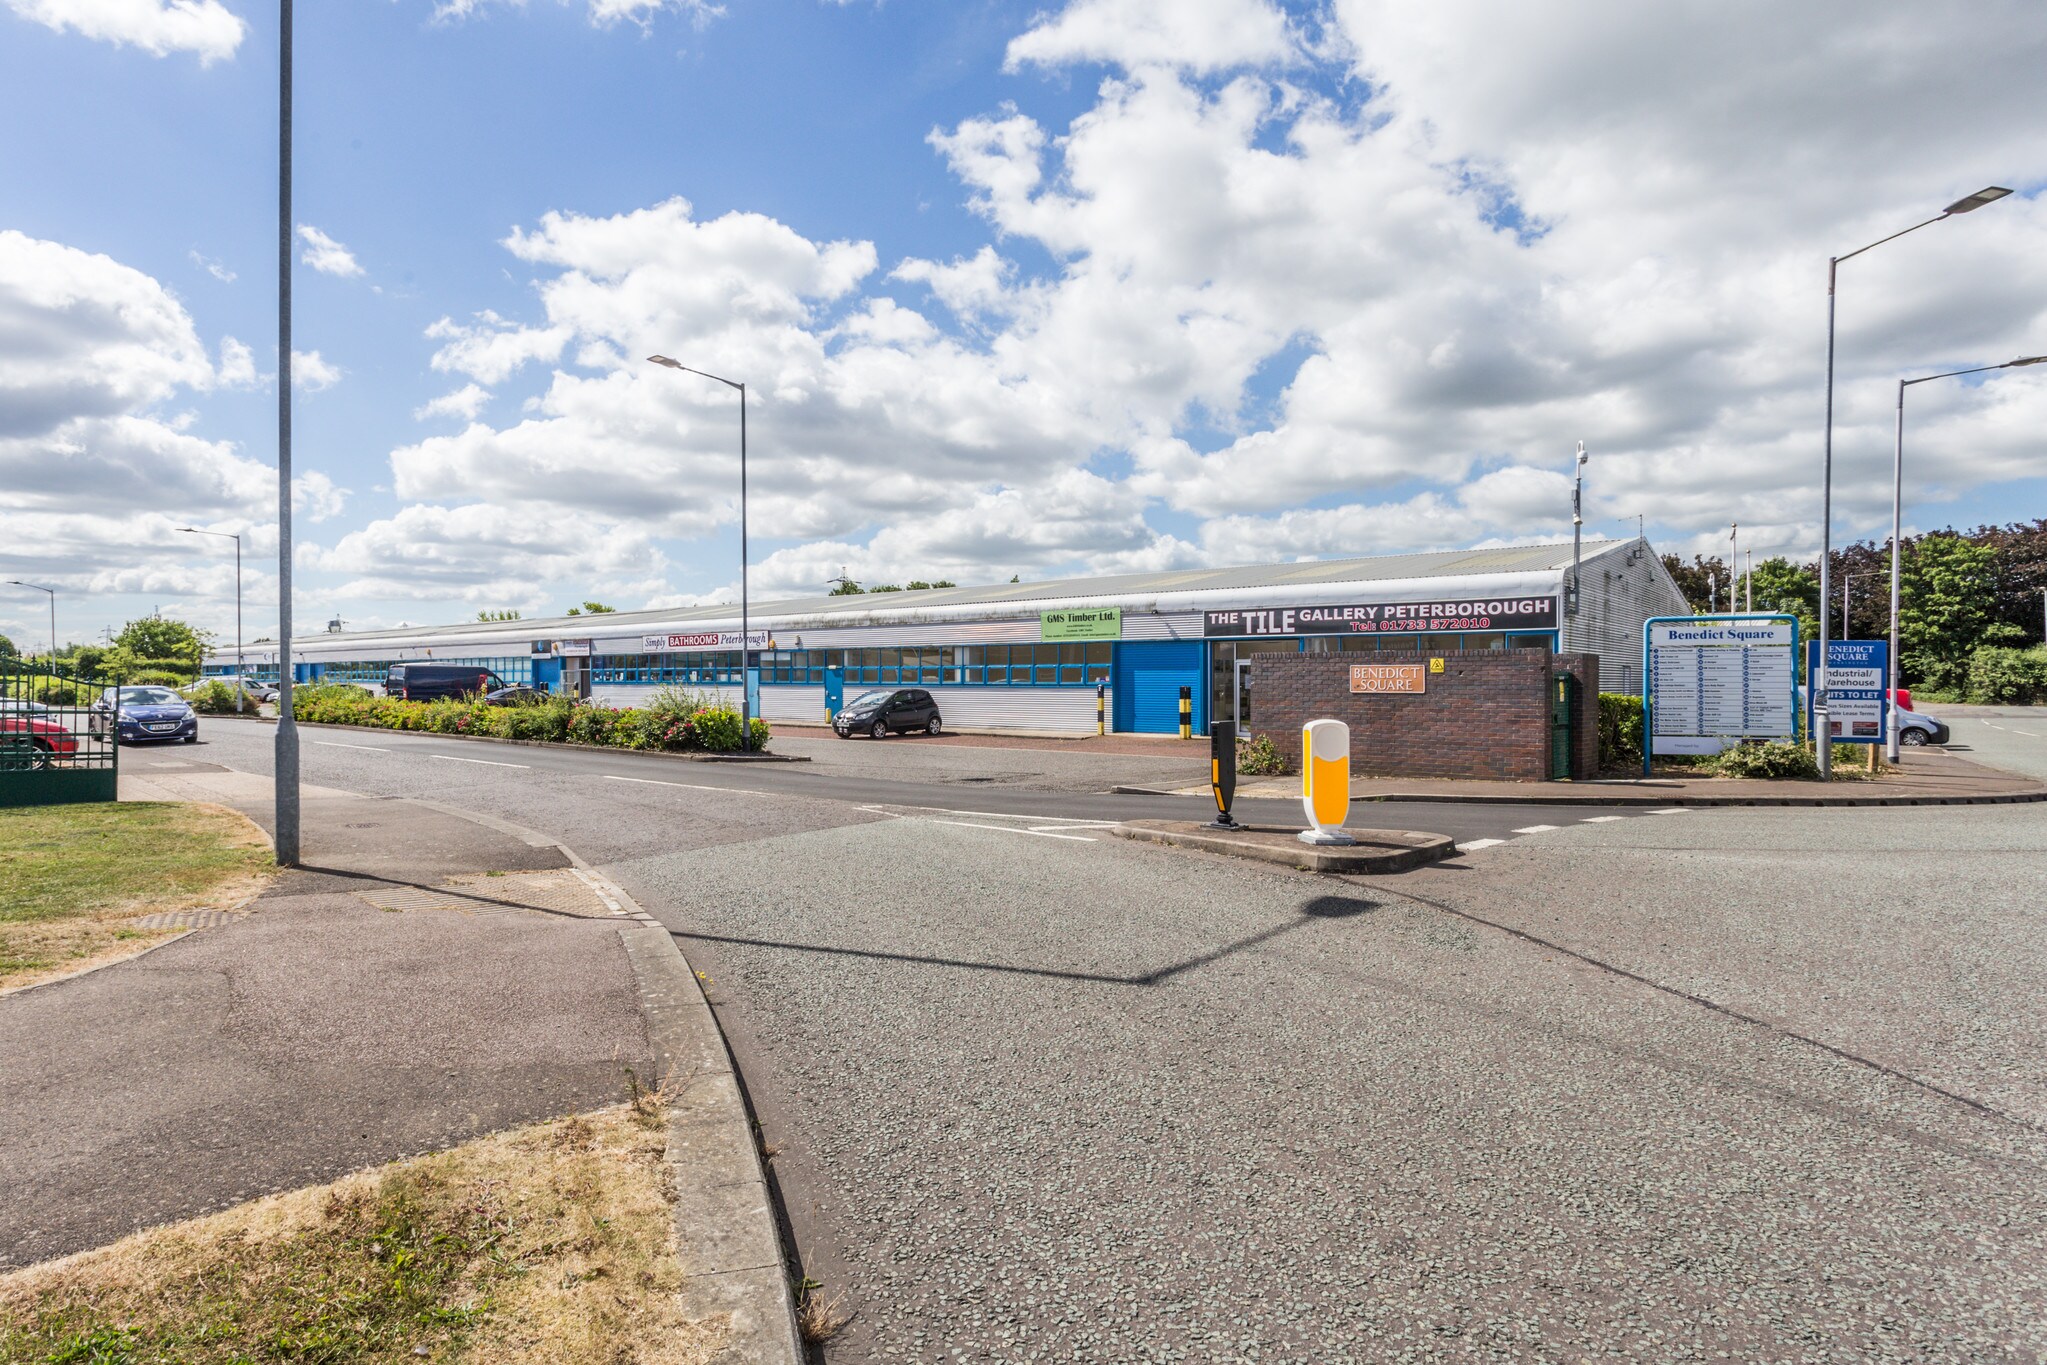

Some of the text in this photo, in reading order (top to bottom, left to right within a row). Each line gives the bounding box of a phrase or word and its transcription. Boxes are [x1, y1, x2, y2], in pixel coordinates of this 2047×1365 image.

[1046, 611, 1116, 624] GMS Timber Ltd.
[1209, 599, 1550, 634] THE TILE GALLERY PETERBOROUGH
[1349, 617, 1490, 632] Tel: 01733 572010
[645, 632, 766, 650] Simply BATHROOMS Peterbrough
[1668, 628, 1775, 641] Benedict Square
[1828, 645, 1874, 653] ENEDICT
[1828, 653, 1869, 661] SQUARE
[1354, 667, 1420, 679] BENEDICT
[1827, 669, 1873, 677] ndustrial/
[1360, 679, 1413, 692] SQUARE
[1827, 678, 1875, 686] arehouse
